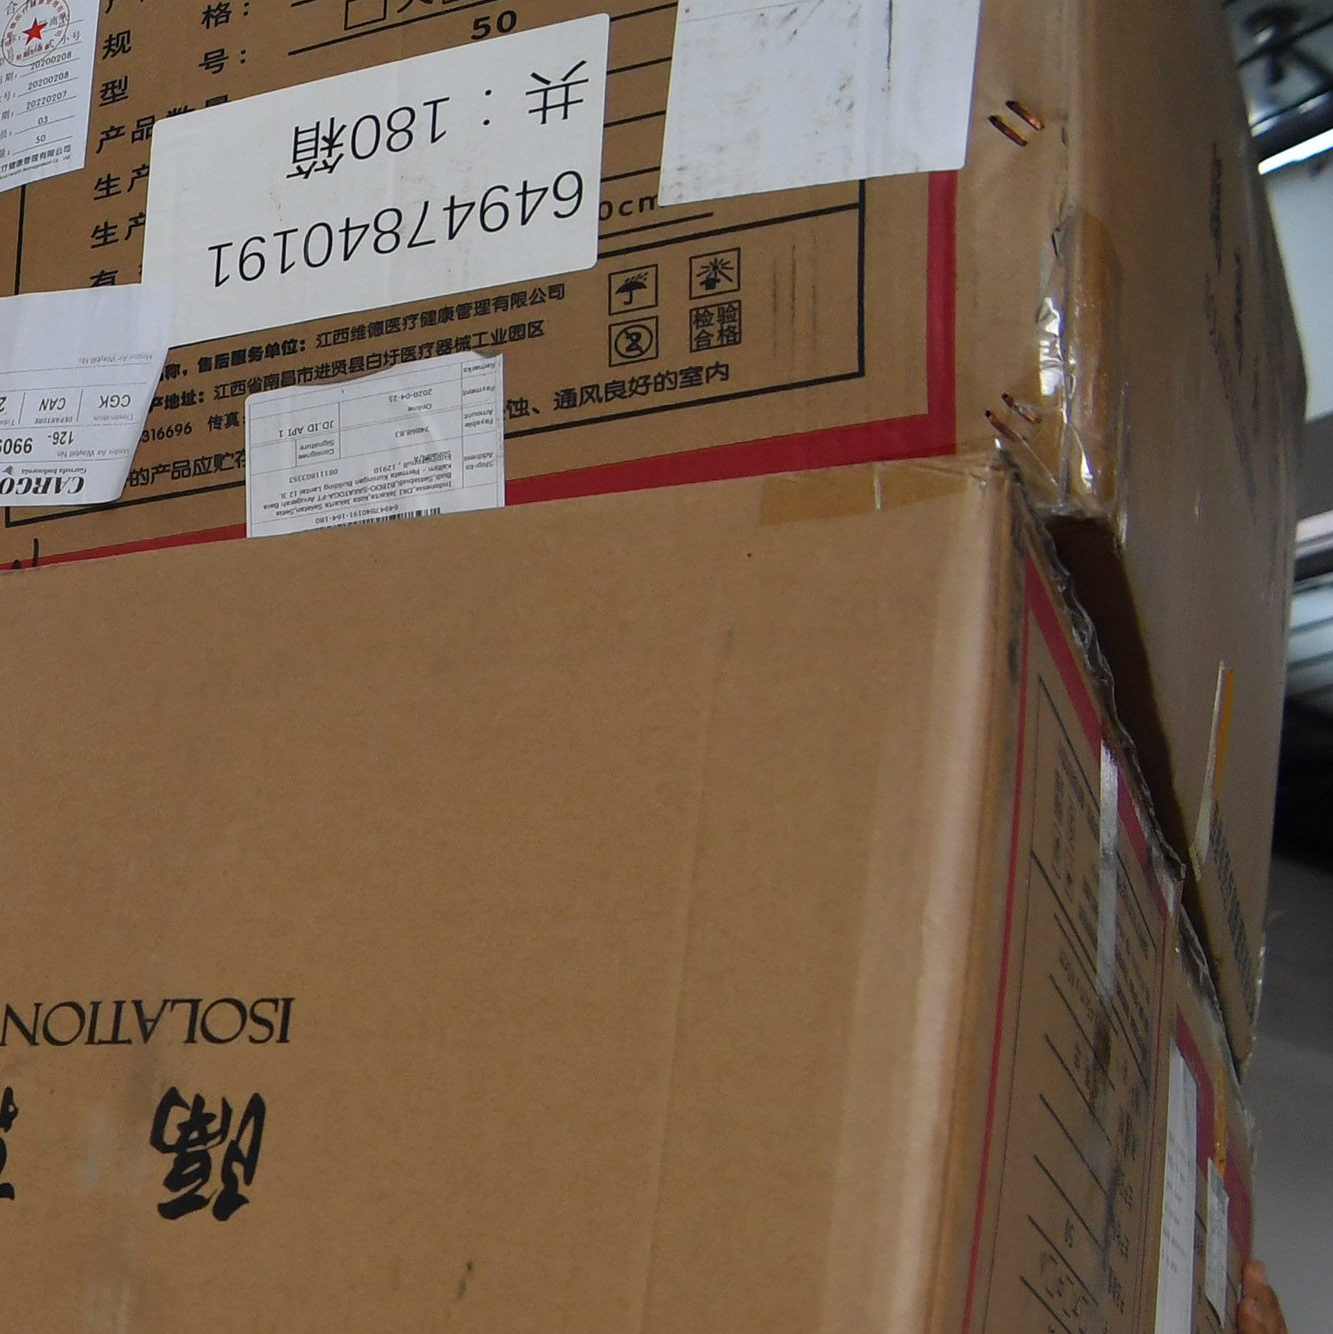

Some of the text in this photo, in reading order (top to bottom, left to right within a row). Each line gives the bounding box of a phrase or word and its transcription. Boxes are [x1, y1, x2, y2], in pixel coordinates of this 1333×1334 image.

[470, 11, 518, 40] 50
[28, 71, 70, 91] 20200208
[26, 91, 67, 110] 20220207
[37, 115, 48, 125] 03
[35, 135, 46, 144] 50
[207, 170, 586, 289] 64947840191
[98, 394, 131, 408] CGK
[388, 388, 432, 403] 2020-04-25
[39, 397, 66, 411] CAN
[286, 424, 304, 436] API
[307, 419, 334, 432] JD.ID
[47, 431, 74, 444] 126-
[0, 995, 295, 1048] ISOLATION
